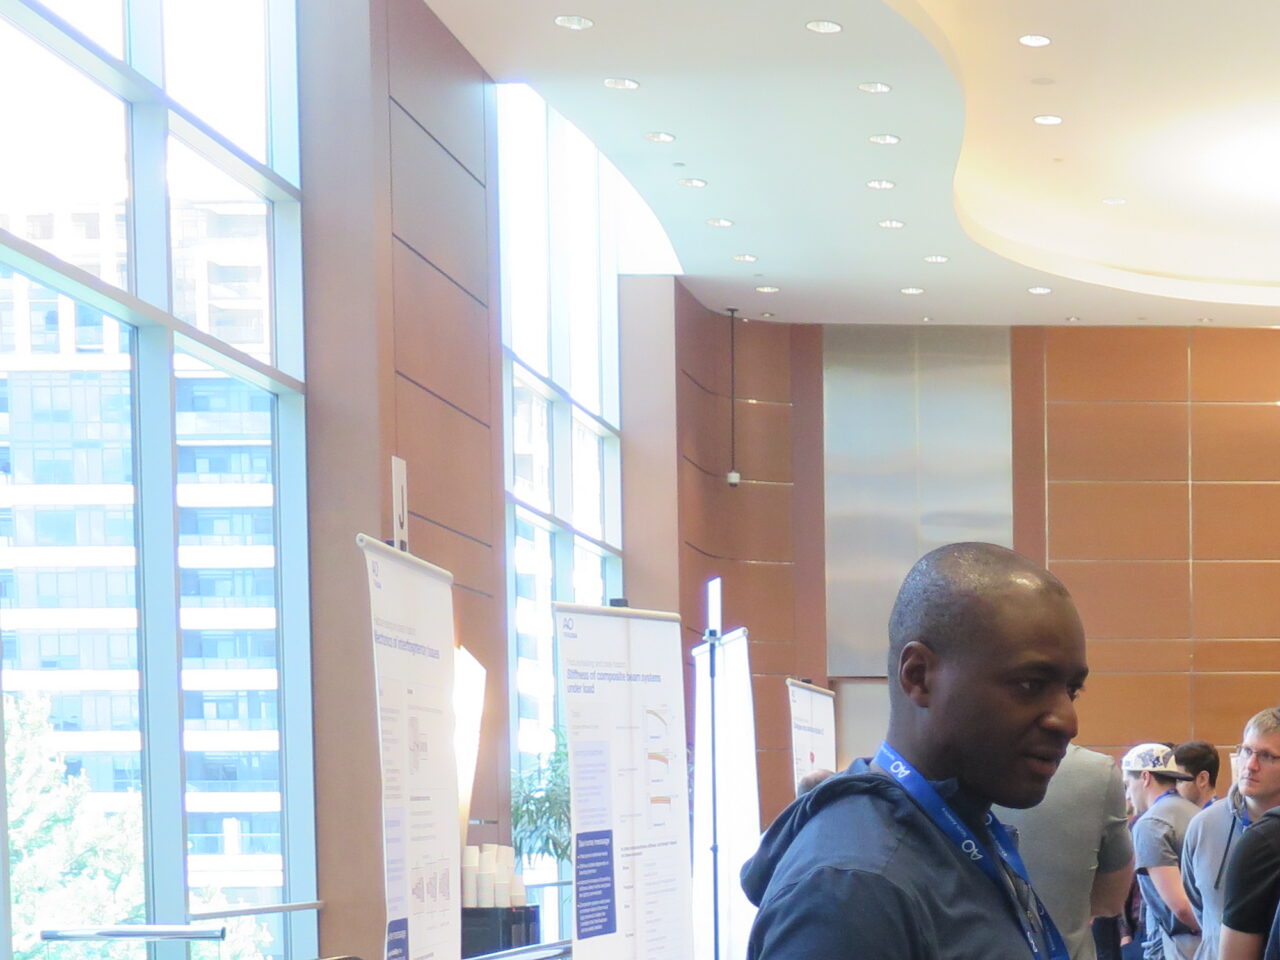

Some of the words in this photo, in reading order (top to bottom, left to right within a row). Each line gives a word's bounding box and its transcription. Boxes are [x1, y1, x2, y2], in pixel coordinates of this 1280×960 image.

[590, 669, 596, 680] of
[890, 761, 911, 778] AO
[962, 840, 984, 861] AO
